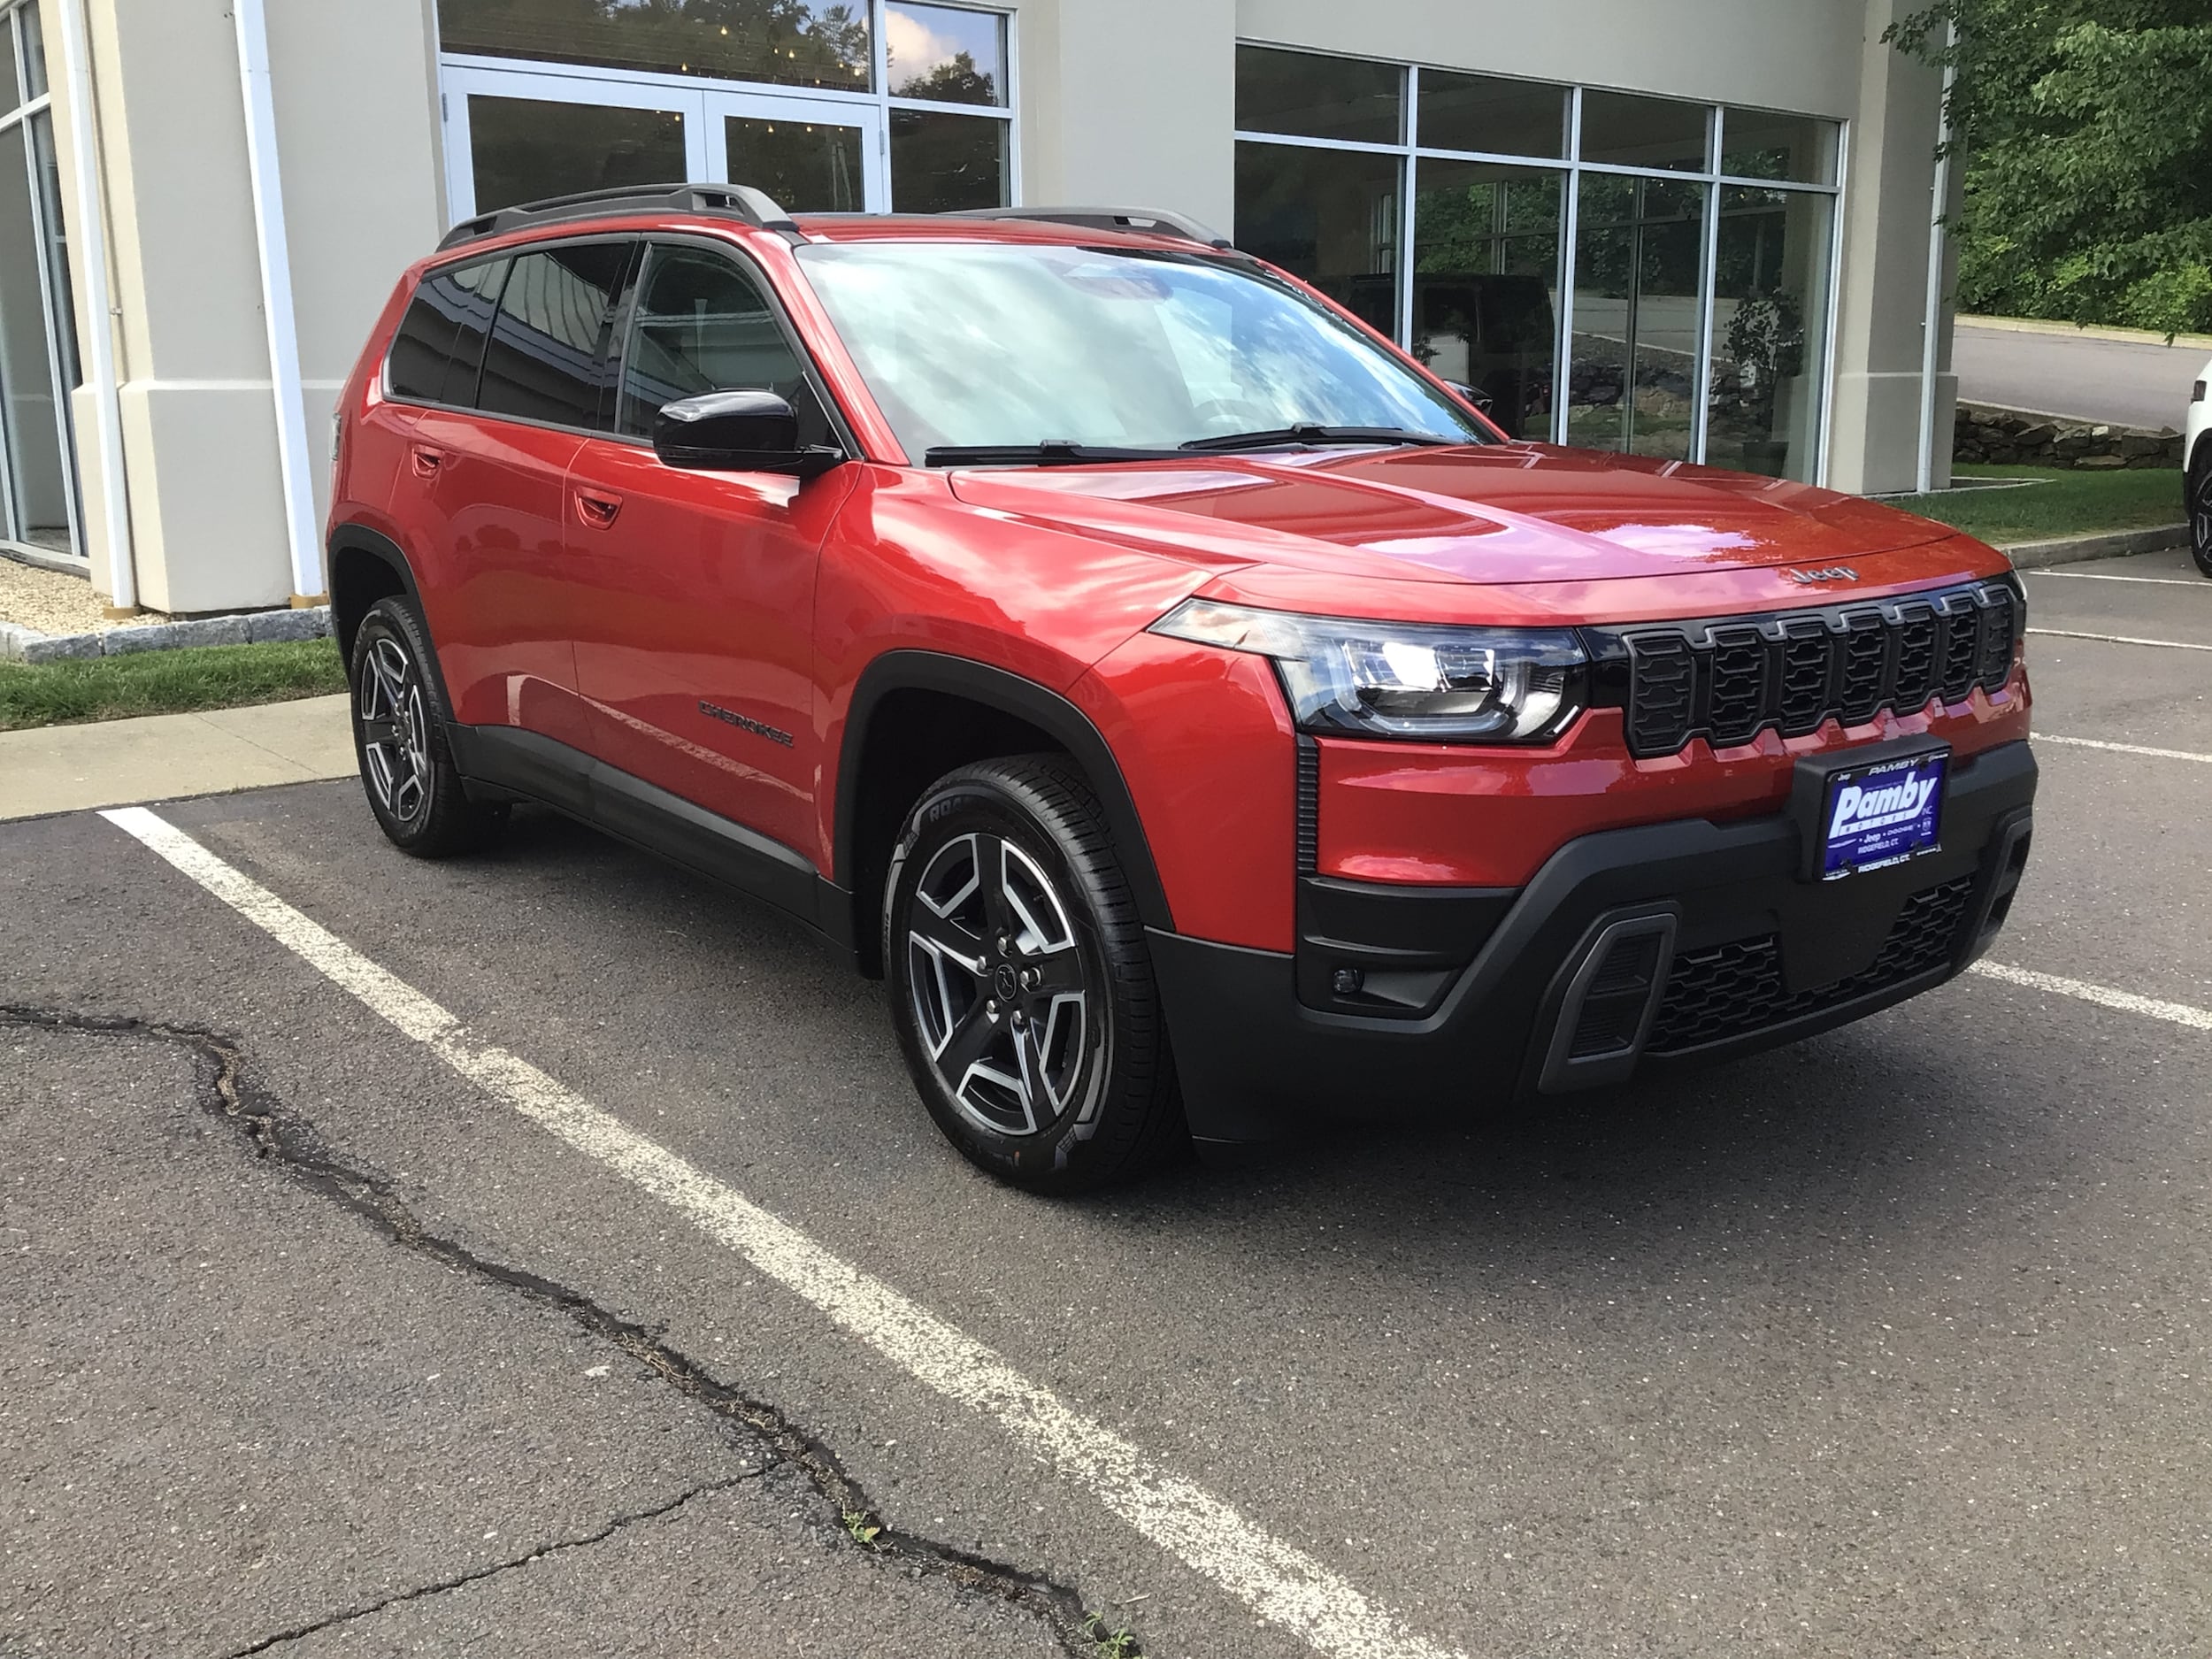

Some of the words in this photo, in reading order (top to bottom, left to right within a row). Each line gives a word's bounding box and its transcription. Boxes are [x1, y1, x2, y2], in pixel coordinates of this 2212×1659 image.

[1789, 566, 1859, 584] Jeep
[698, 700, 794, 749] CHEROKEE
[1869, 758, 1919, 776] PAMBY
[1828, 771, 1938, 839] Pamby
[1863, 833, 1881, 844] Jeep
